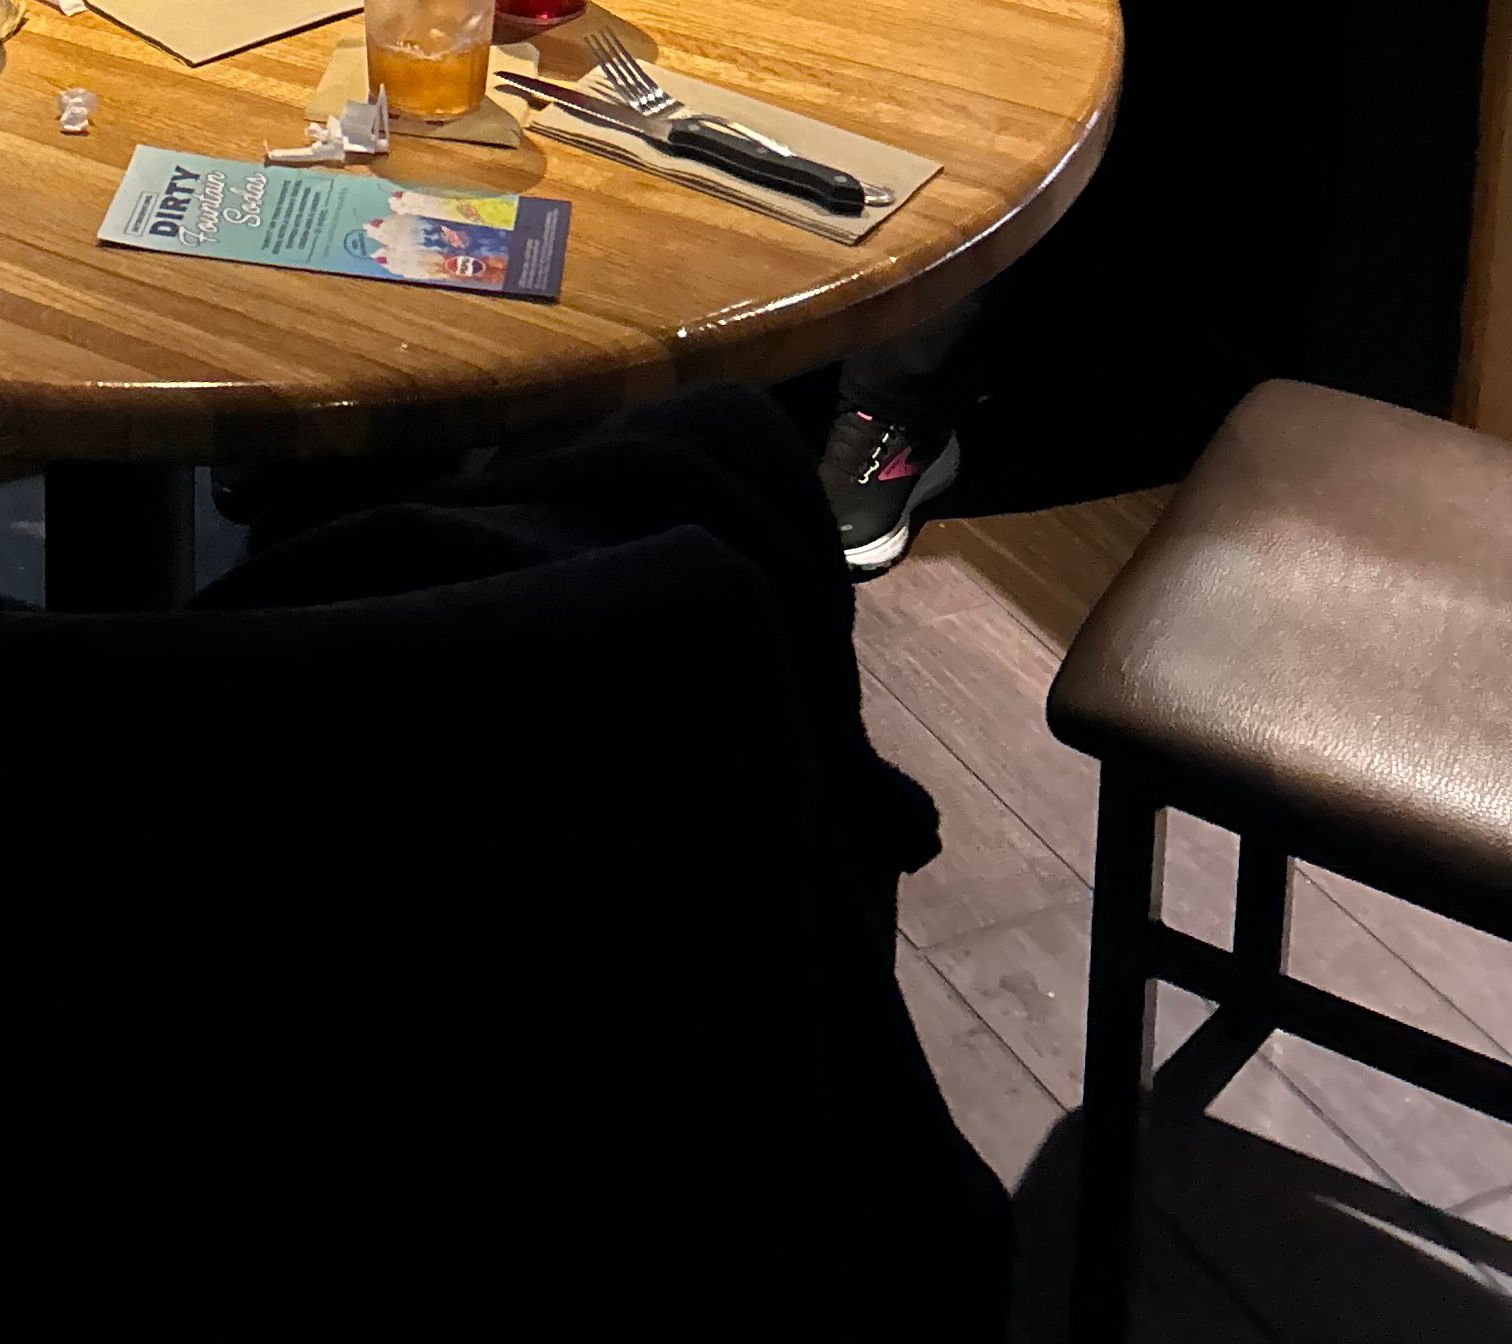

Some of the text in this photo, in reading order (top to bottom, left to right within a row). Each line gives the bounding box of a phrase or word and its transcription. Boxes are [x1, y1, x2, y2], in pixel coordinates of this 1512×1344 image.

[148, 164, 201, 238] DIRTY
[178, 170, 226, 248] Fountain
[222, 172, 267, 228] Sodas
